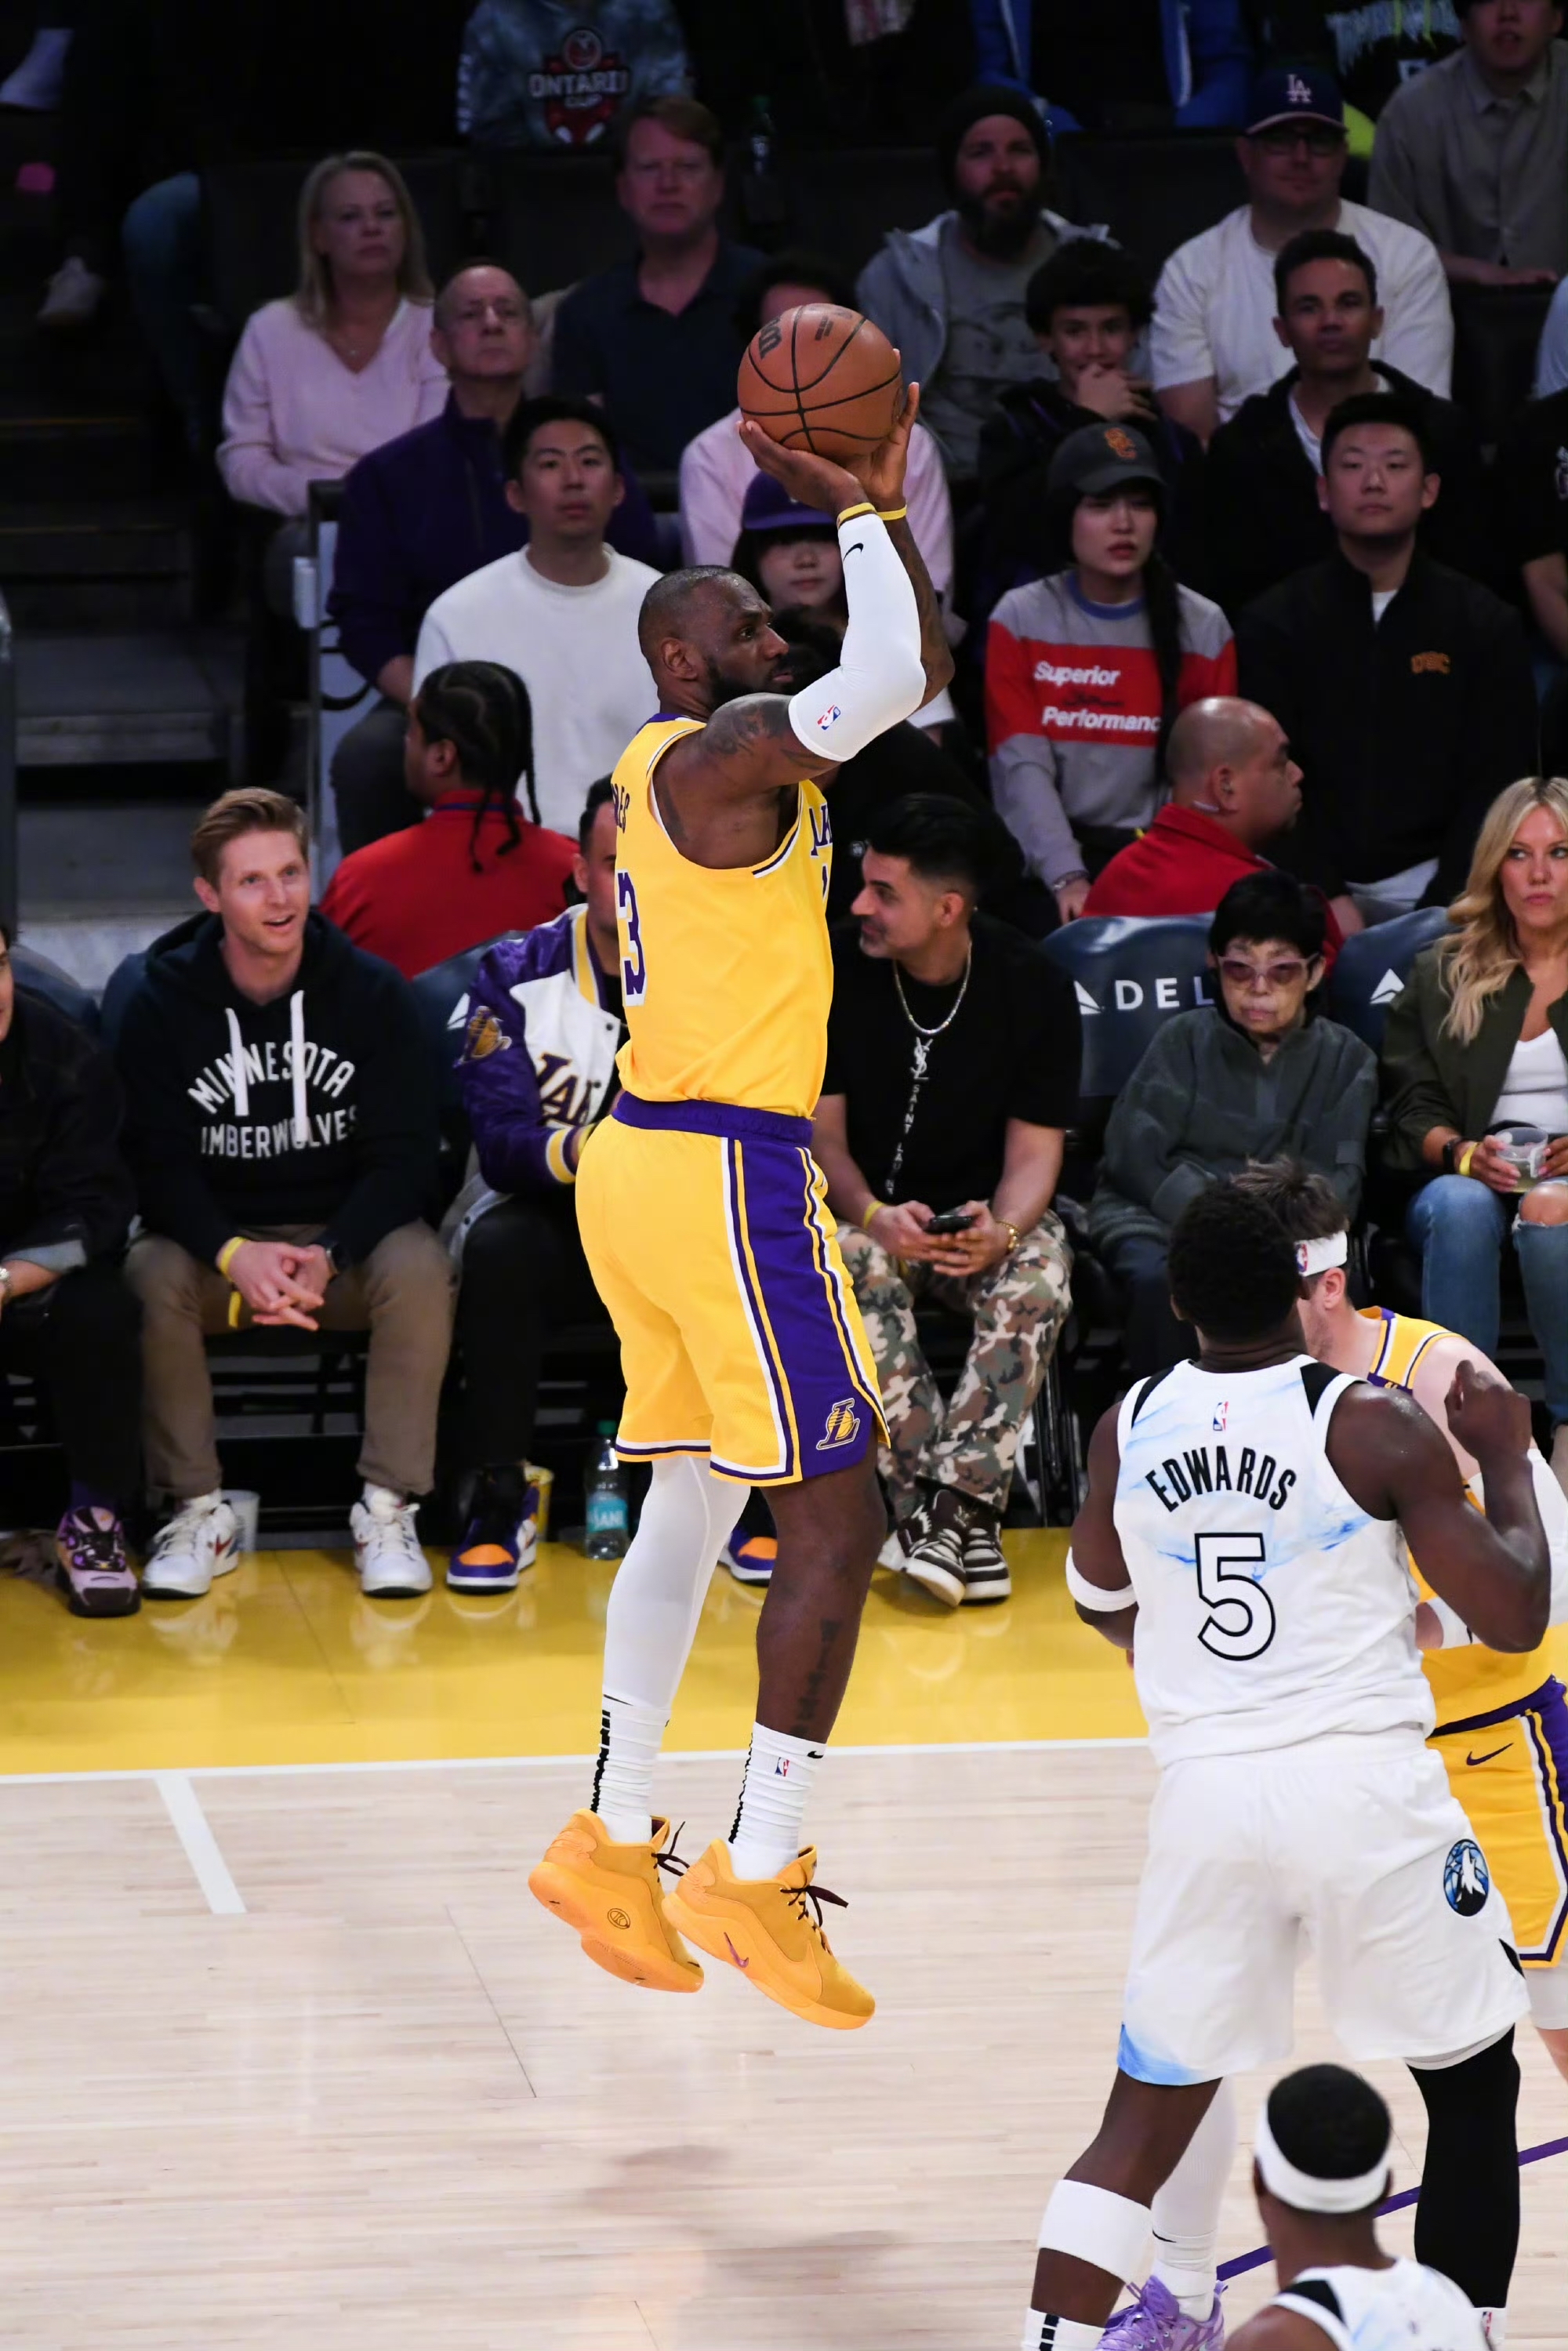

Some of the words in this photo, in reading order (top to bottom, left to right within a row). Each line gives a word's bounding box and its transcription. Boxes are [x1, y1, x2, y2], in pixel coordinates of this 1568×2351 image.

[1287, 74, 1312, 103] LA
[1034, 661, 1121, 687] Superior
[905, 1084, 921, 1134] SAINT
[1145, 1446, 1297, 1513] EDWARDS
[1194, 1533, 1276, 1661] 5
